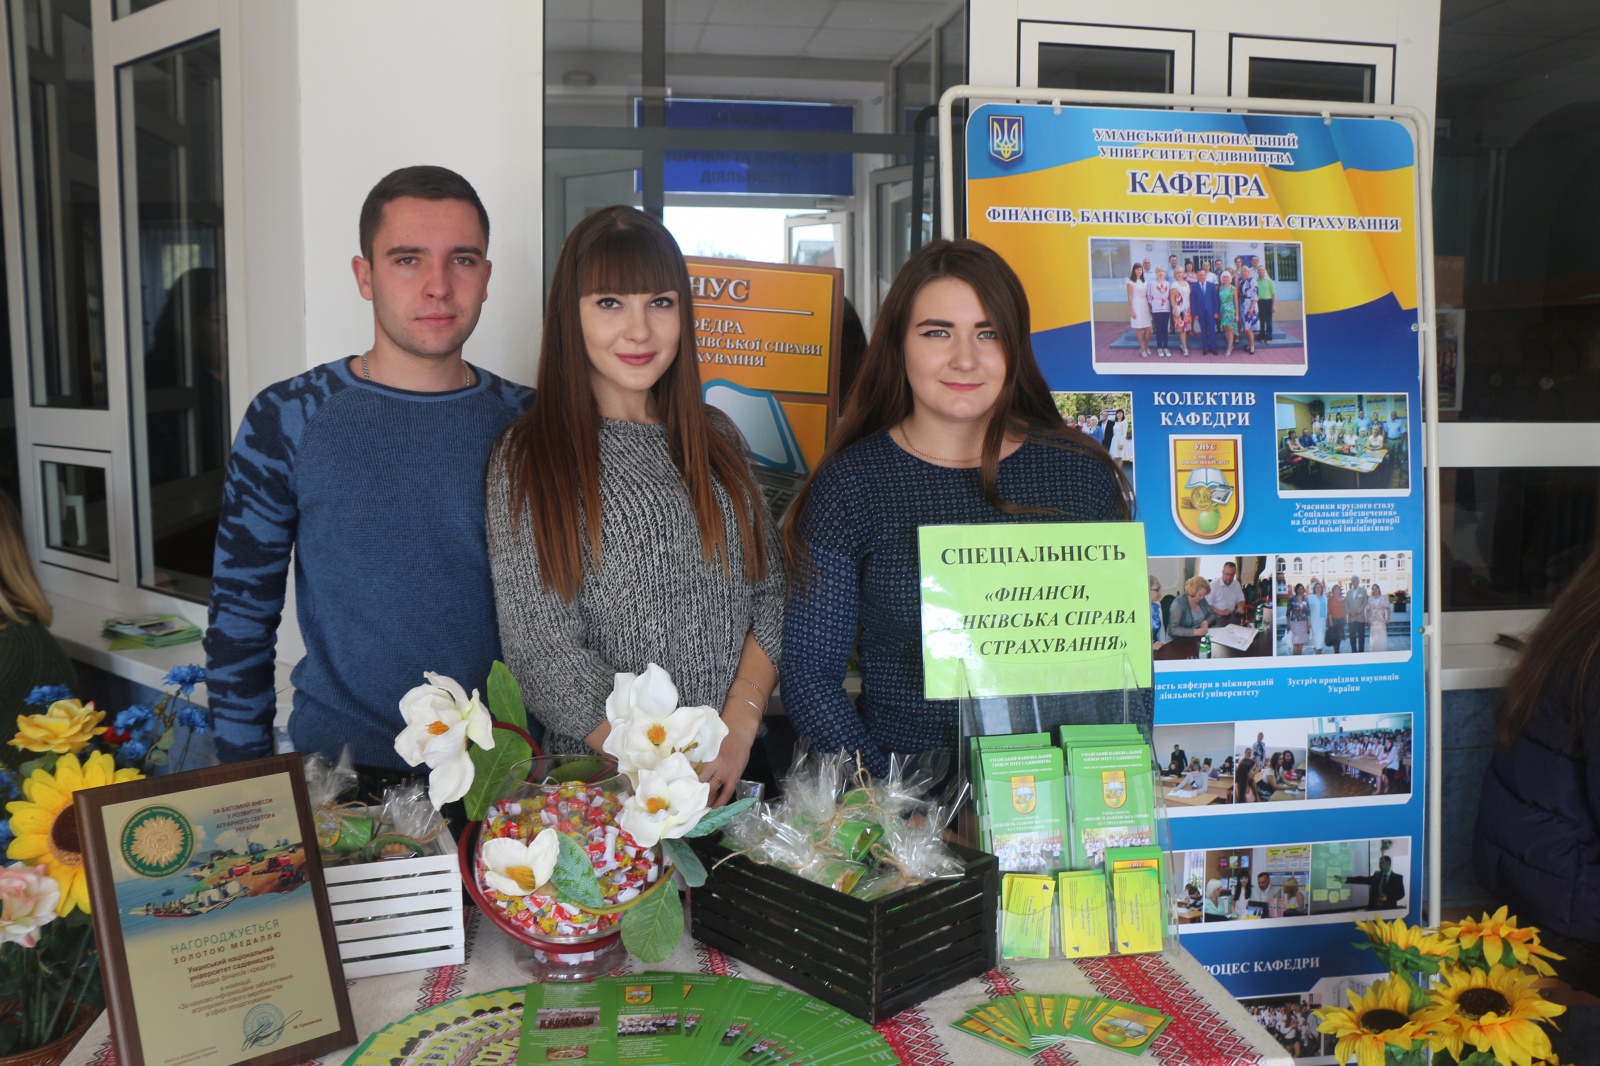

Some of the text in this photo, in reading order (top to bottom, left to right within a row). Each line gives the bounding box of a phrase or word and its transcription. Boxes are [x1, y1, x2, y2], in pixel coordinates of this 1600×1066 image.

[1094, 128, 1298, 149] УМАНСЬКИЙ НАЦІОНАЛЬНИЙ
[1099, 146, 1294, 166] УНІВЕРСИТЕТ САДІВНИЦТВА
[1129, 171, 1266, 201] КАФЕДРА
[987, 206, 1401, 232] ФІНАНСІВ, БАНКІВСЬКОЇ СПРАВИ ТА СТРАХУВАННЯ
[690, 276, 750, 302] НУС
[696, 336, 822, 356] КІВСЬКОЇ СПРАВИ
[698, 352, 766, 367] ХУВАННЯ
[1153, 391, 1256, 406] КОЛЕКТИВ
[1160, 411, 1251, 427] КАФЕДРИ
[1295, 502, 1395, 511] Учасники круглого столу
[1302, 518, 1318, 526] базі
[1319, 517, 1354, 526] наукової
[1354, 516, 1401, 525] лабораторії
[941, 545, 1126, 566] СПЕЦІАЛЬНІСТЬ
[985, 585, 1090, 602] «ФІНАНСИ,
[962, 609, 1136, 630] НКІВСЬКА СПРАВА
[979, 635, 1128, 656] СТРАХУВАННЯ»
[1178, 682, 1212, 691] кафедри
[1222, 678, 1275, 688] міжнародній
[1287, 673, 1400, 687] Зустріч провідних науковців
[1328, 684, 1361, 694] України
[1159, 689, 1260, 700] діяльності університету
[221, 801, 251, 812] ВАГОМИЙ
[232, 808, 262, 818] РОЗВИТОК
[216, 812, 276, 829] АГРАРНОГО СЕКТОРА
[170, 919, 280, 955] НАГОРОДЖУЄТЬСЯ
[173, 931, 282, 965] ЗОЛОТОЮ МЕДАЛЛЮ
[187, 946, 275, 974] Уманський національний
[189, 954, 275, 982] університет садівництва
[1203, 957, 1321, 977] РОЦЕС КАФЕДРИ
